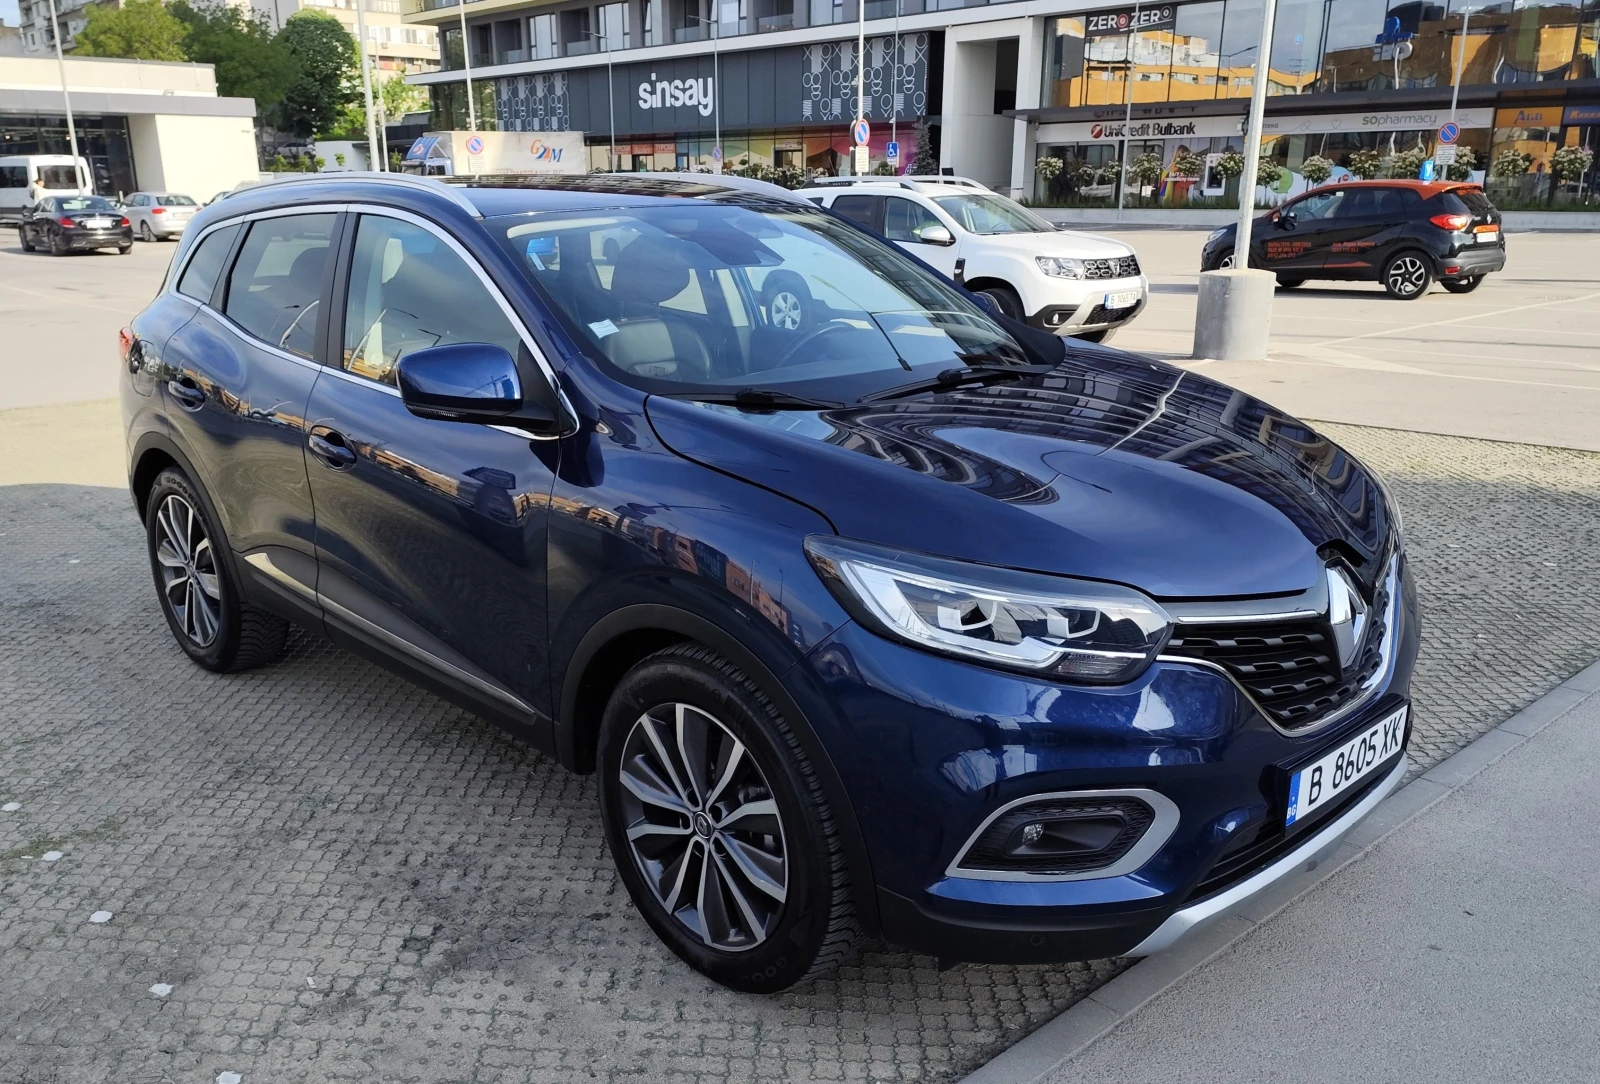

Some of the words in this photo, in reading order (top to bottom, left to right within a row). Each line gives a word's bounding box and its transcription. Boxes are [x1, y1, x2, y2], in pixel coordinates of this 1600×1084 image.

[638, 72, 714, 117] sinsay
[1104, 123, 1151, 138] UniCredit
[1152, 121, 1196, 136] Bulbank
[1118, 294, 1129, 304] 1065
[1308, 765, 1323, 806] B
[1332, 729, 1379, 789] 8605
[1379, 712, 1403, 760] XK
[1286, 804, 1297, 819] BG
